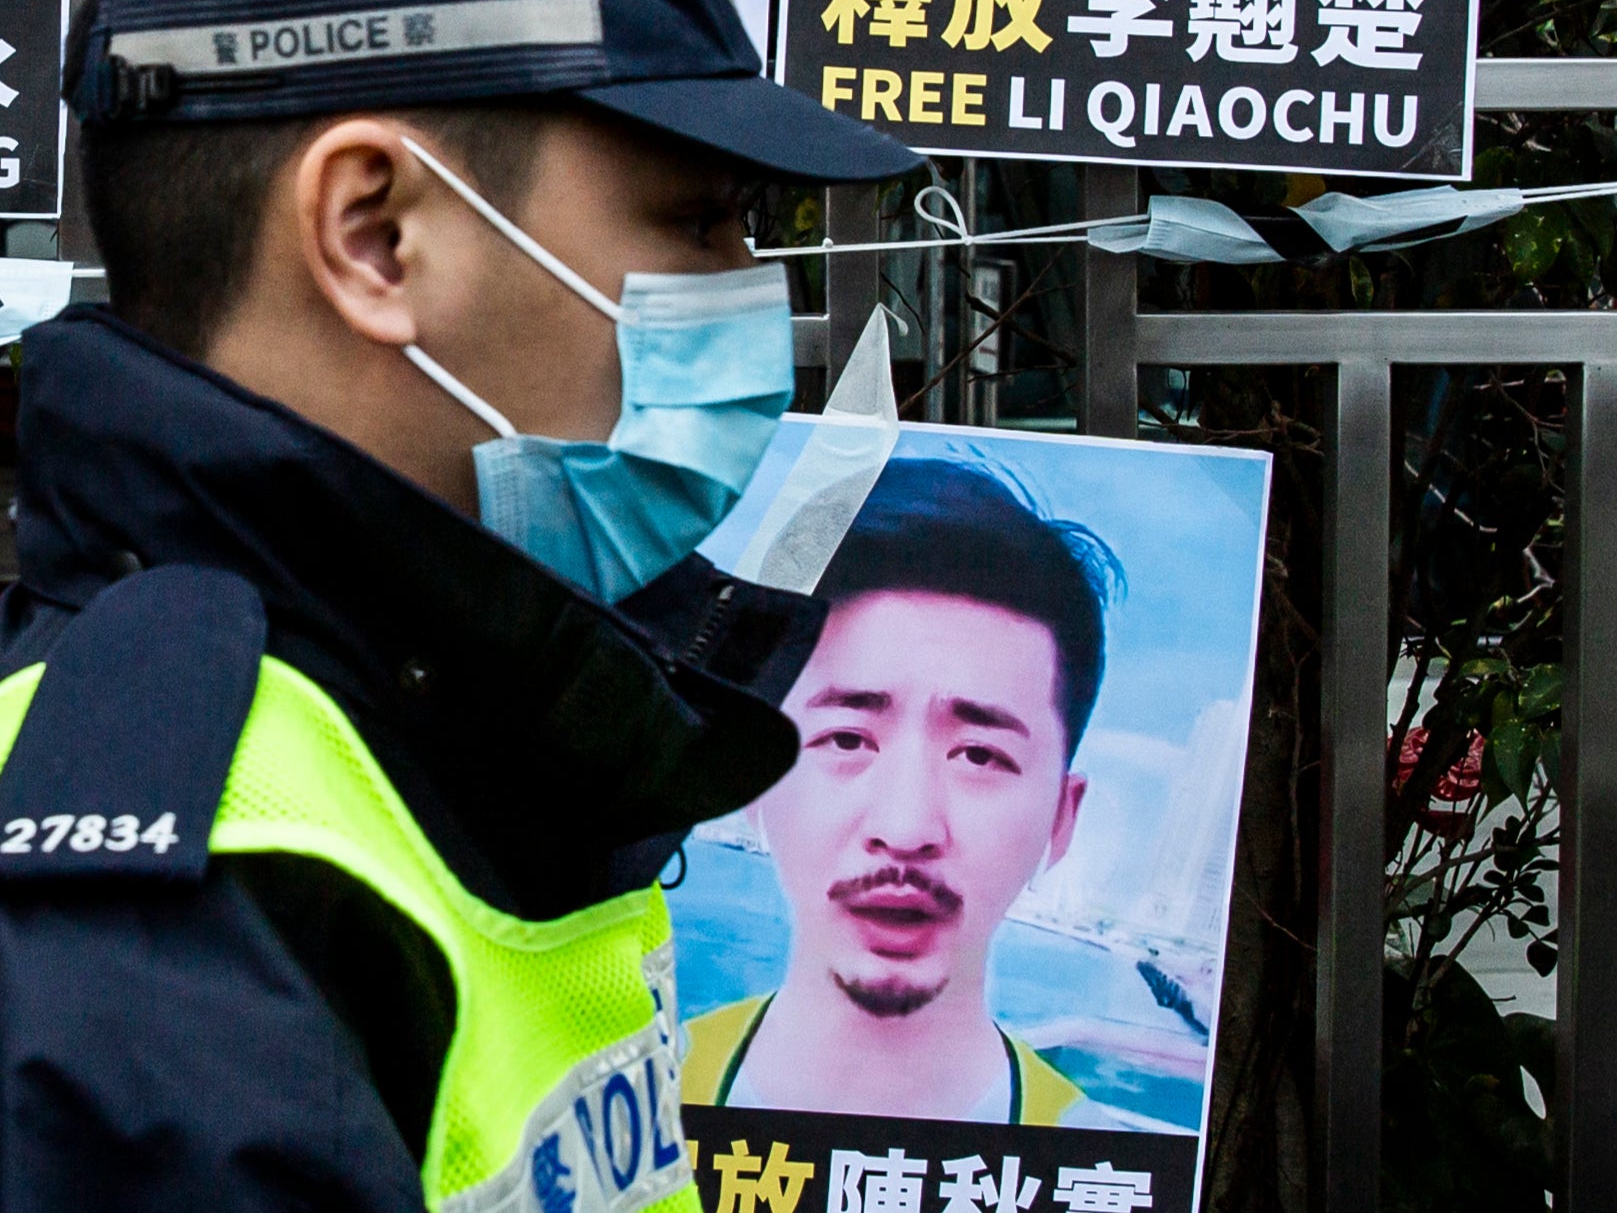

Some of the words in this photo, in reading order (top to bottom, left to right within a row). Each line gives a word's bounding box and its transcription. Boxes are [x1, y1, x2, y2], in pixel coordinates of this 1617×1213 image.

[250, 16, 390, 60] POLICE
[821, 66, 987, 126] FREE
[1009, 76, 1064, 131] LI
[1086, 81, 1419, 148] QIAOCHU
[0, 812, 179, 854] 27834
